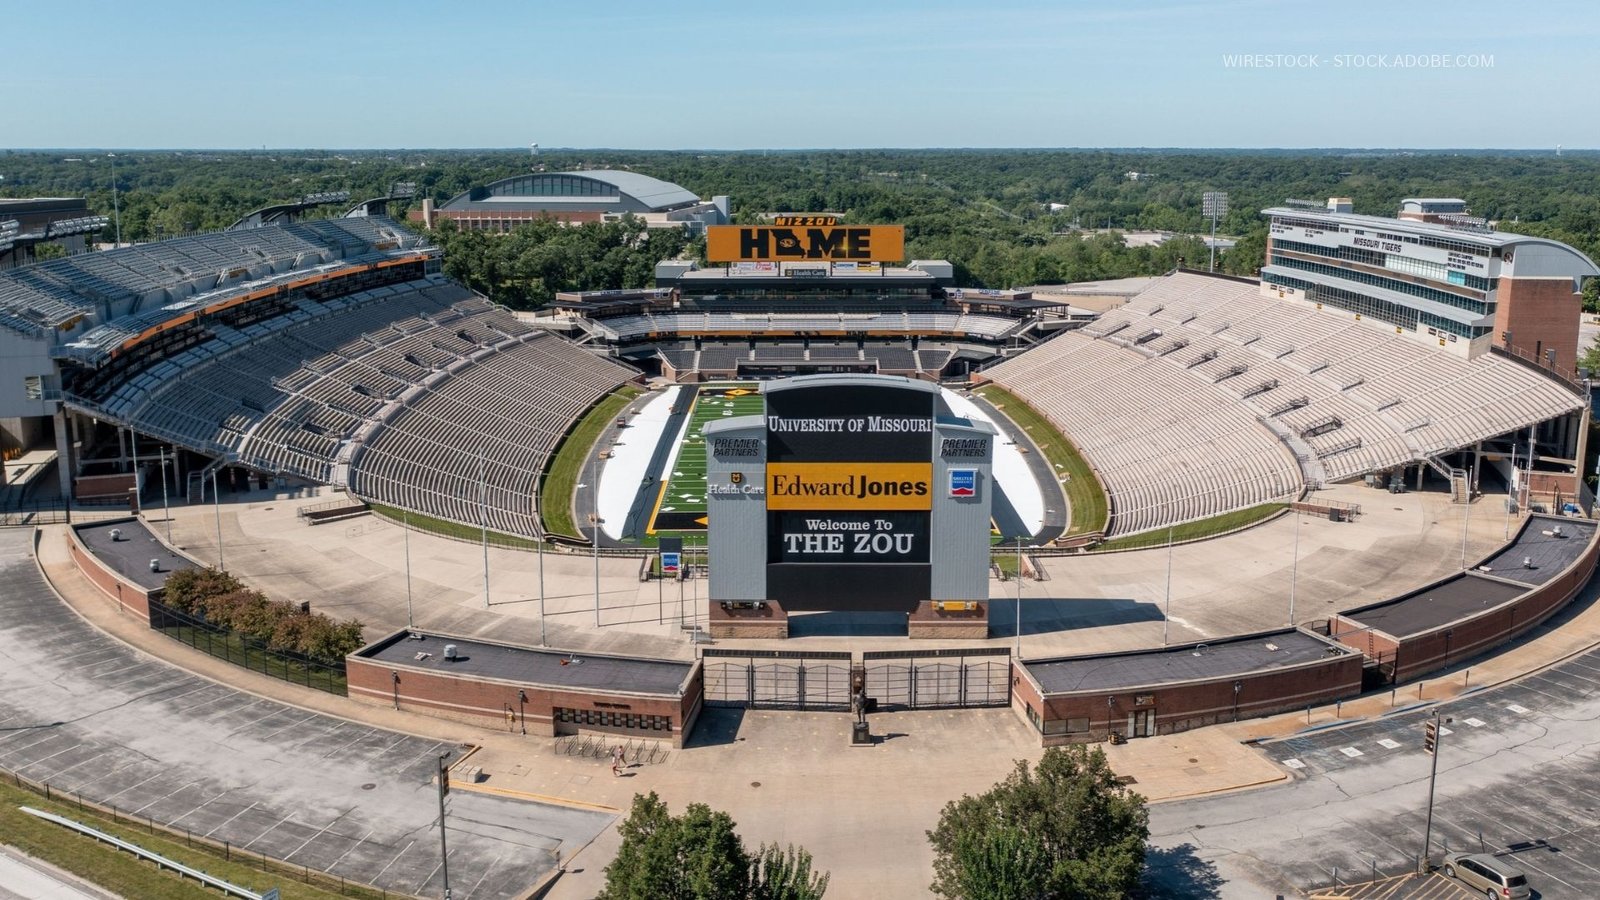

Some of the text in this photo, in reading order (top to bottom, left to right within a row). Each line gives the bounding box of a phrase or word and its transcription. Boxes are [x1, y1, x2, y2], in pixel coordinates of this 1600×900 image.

[775, 217, 836, 226] MIZZOU
[740, 228, 871, 259] HME
[1353, 237, 1402, 253] MISSOURI TIGERS
[768, 415, 932, 433] UNIVERSITY OF MISSOURI
[714, 438, 759, 449] PREMIER
[941, 438, 987, 449] PREMIER
[713, 448, 759, 457] PARTNERS
[940, 448, 986, 458] PARTNERS
[708, 485, 764, 494] Health Care
[772, 474, 928, 499] Edward Jones
[805, 520, 893, 531] Welcome To
[784, 533, 914, 554] THE ZOU
